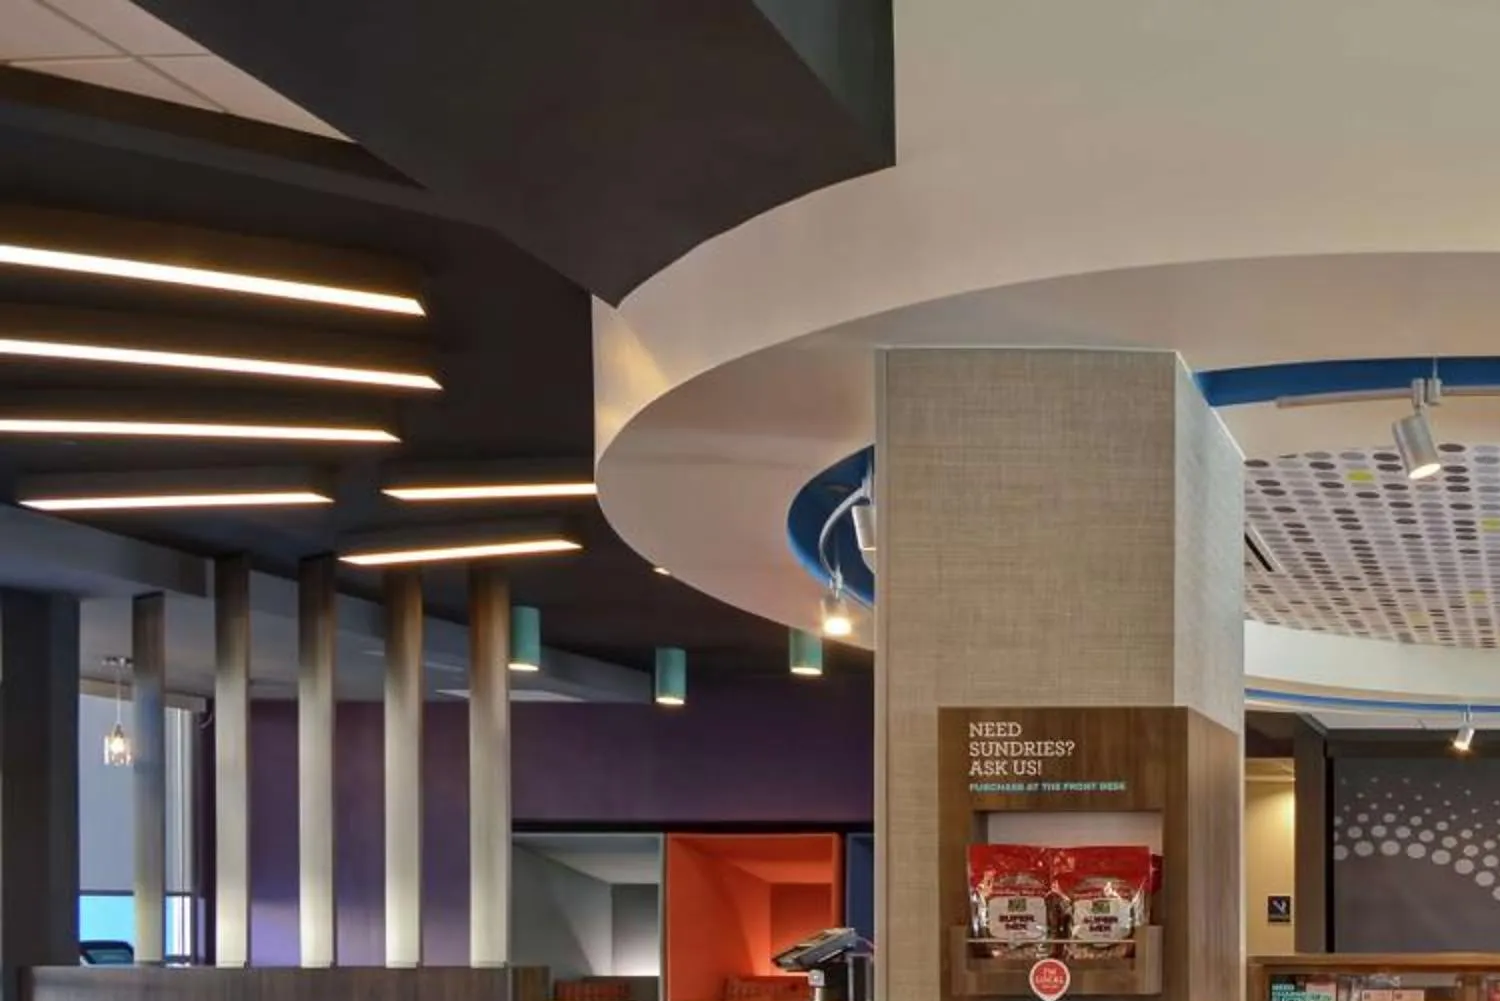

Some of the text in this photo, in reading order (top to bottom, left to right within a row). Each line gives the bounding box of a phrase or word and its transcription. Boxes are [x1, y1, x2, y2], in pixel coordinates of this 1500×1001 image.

[969, 722, 1022, 737] NEED
[969, 741, 1075, 757] SUNDRIES?
[969, 760, 1042, 776] ASK US!
